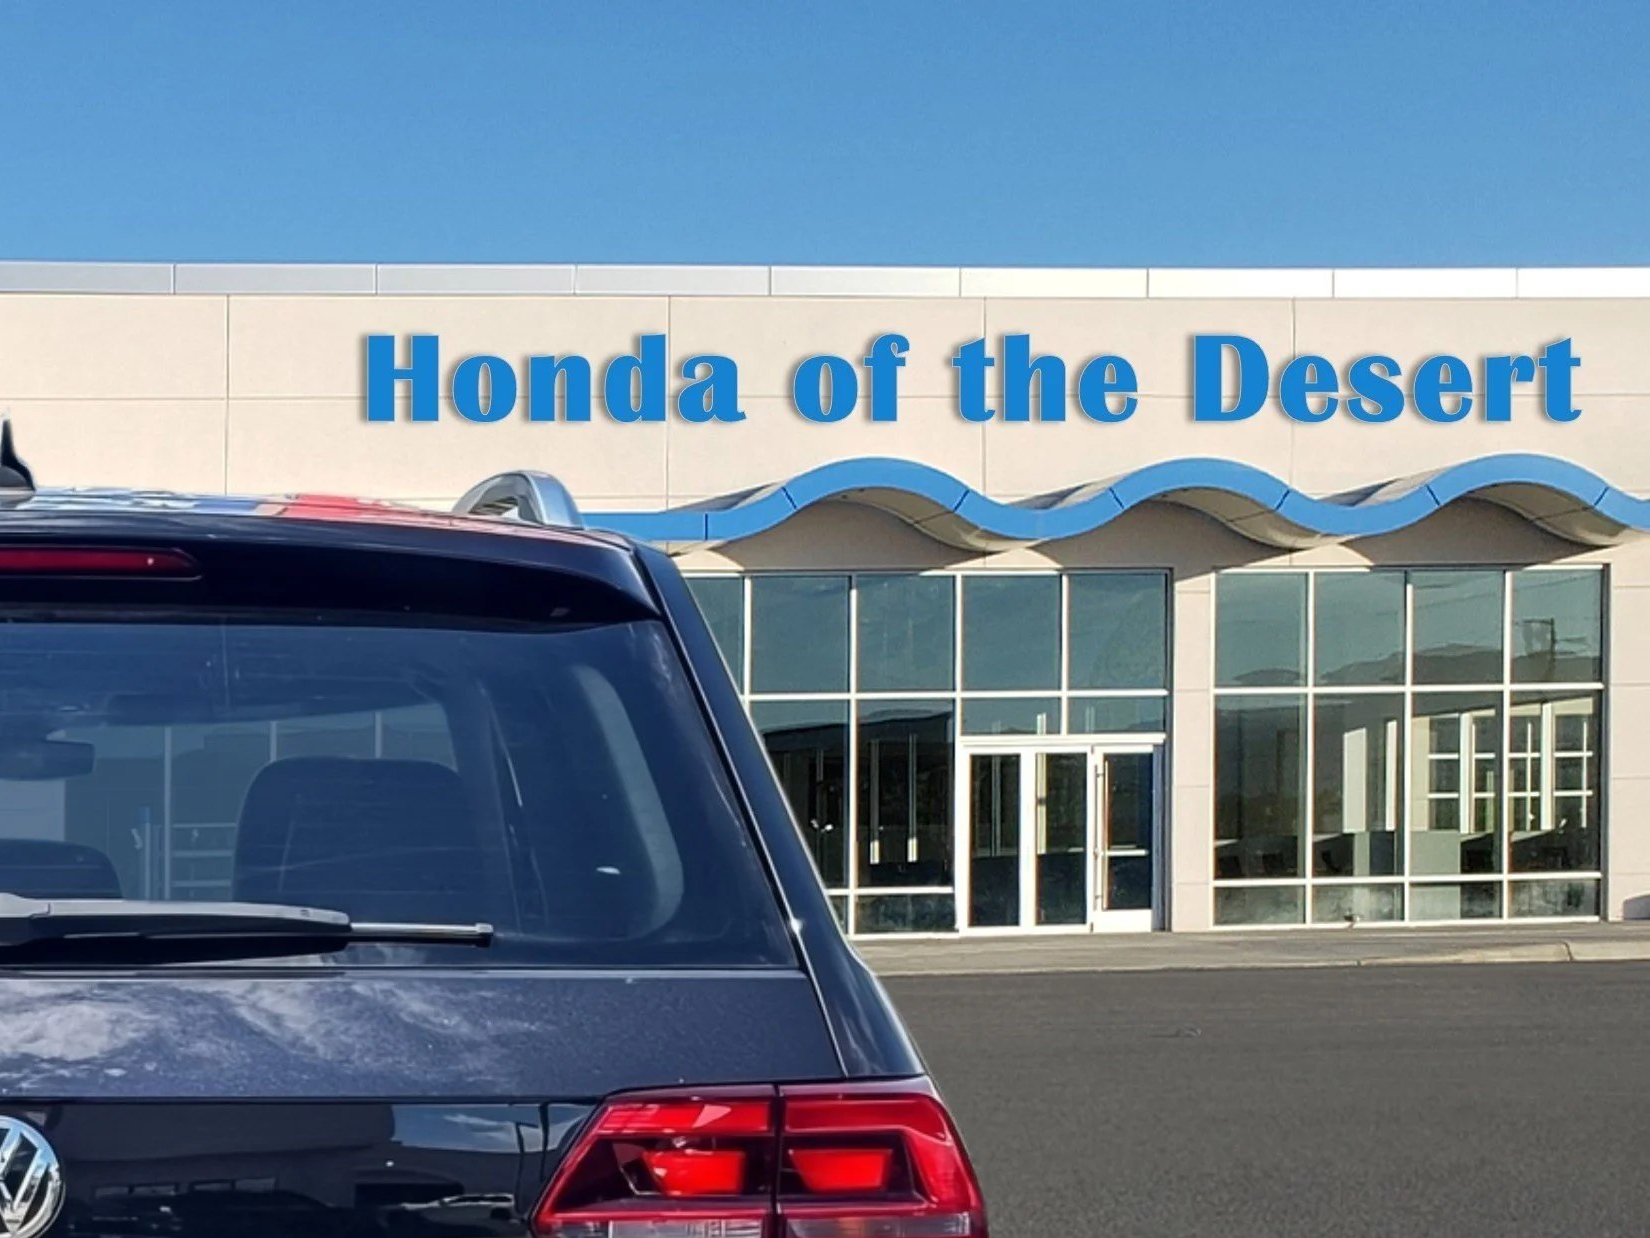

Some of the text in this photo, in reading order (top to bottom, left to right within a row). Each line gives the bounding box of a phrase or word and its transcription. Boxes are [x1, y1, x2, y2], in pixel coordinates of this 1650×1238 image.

[365, 333, 1582, 423] Honda of the Desert
